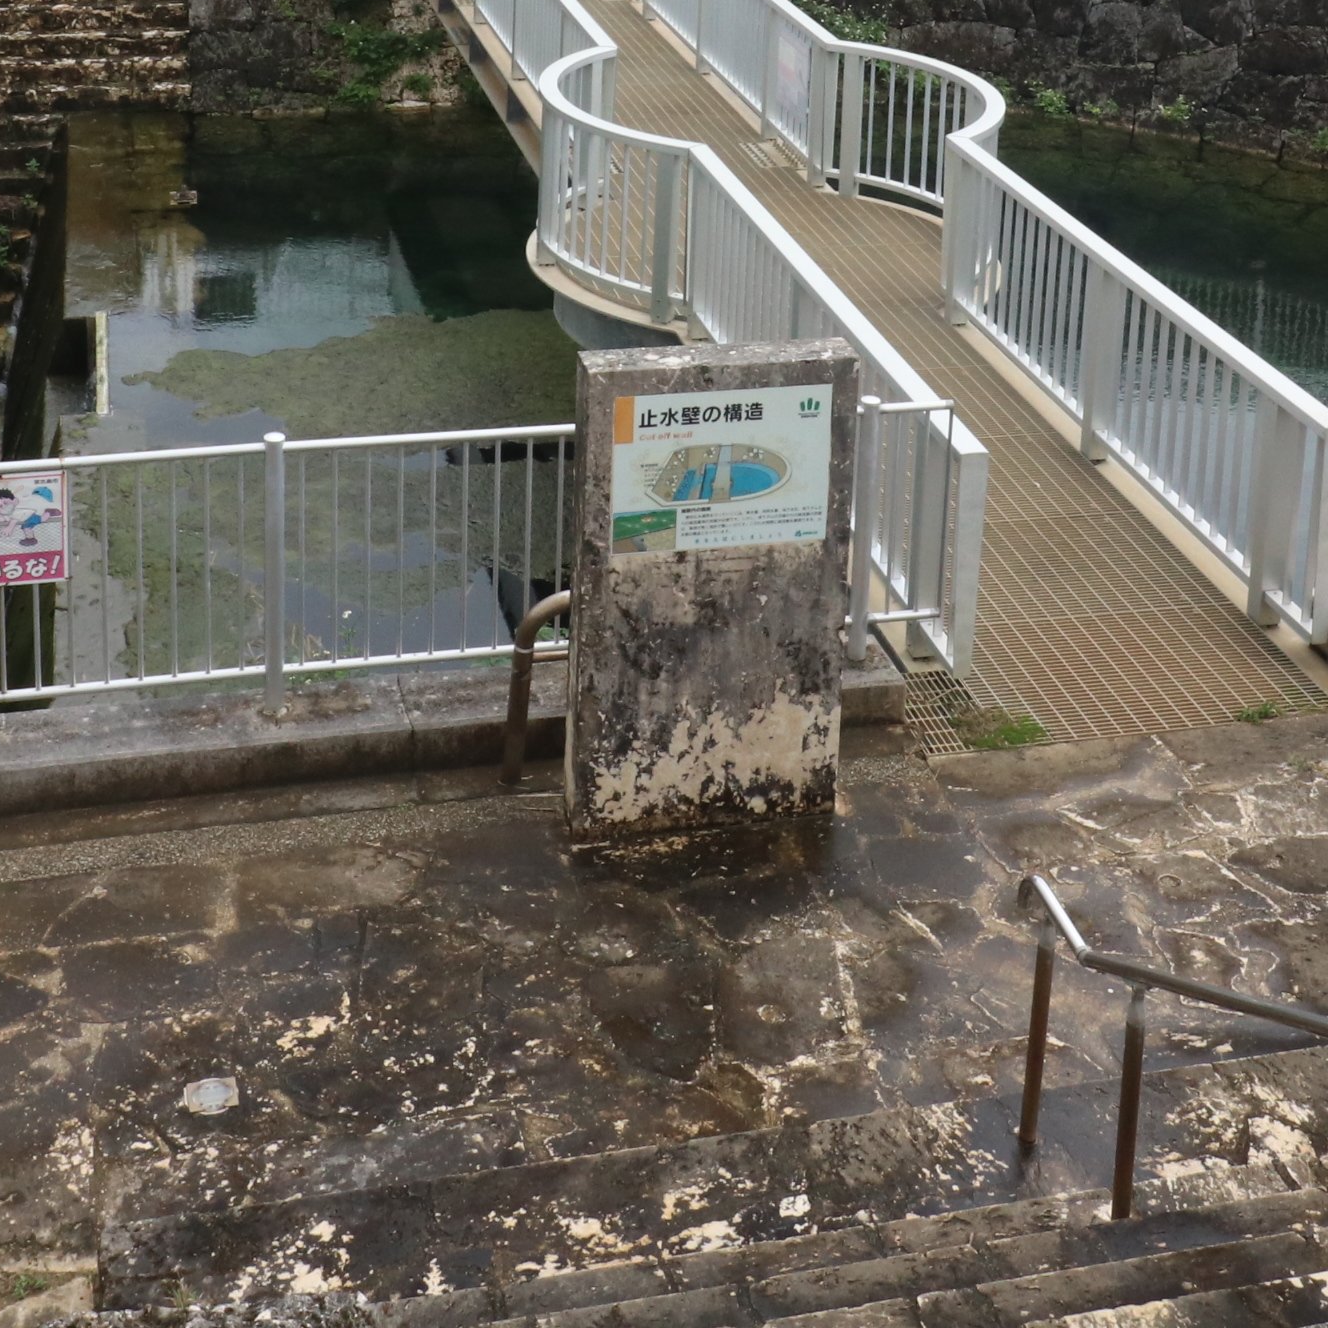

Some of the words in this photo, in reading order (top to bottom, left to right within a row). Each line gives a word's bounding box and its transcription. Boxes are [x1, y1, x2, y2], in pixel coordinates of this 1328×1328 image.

[638, 402, 764, 429] 止水壁の構造
